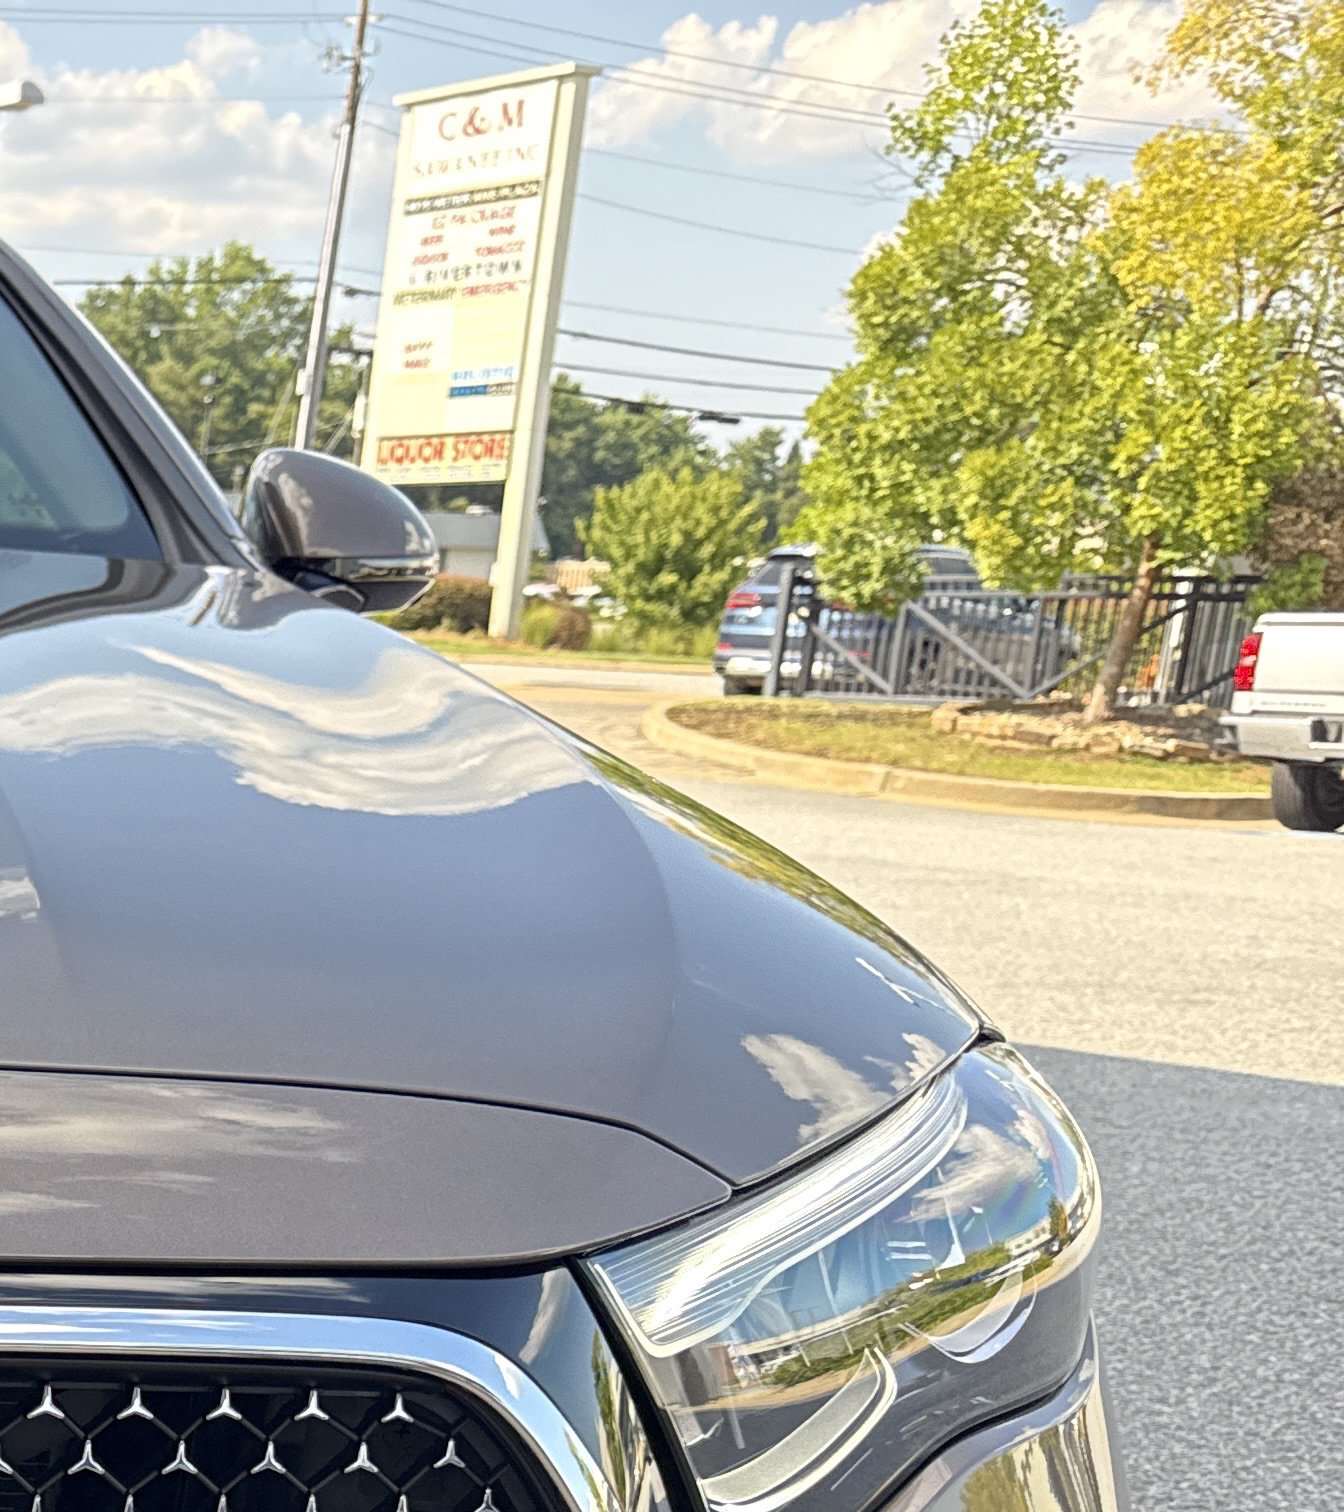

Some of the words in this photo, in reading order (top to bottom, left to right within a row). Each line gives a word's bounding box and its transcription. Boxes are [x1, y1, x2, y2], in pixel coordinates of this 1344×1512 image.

[438, 113, 457, 141] C
[462, 106, 490, 137] &
[498, 100, 525, 132] M
[377, 438, 446, 465] LIQUOR
[452, 433, 508, 460] STORE
